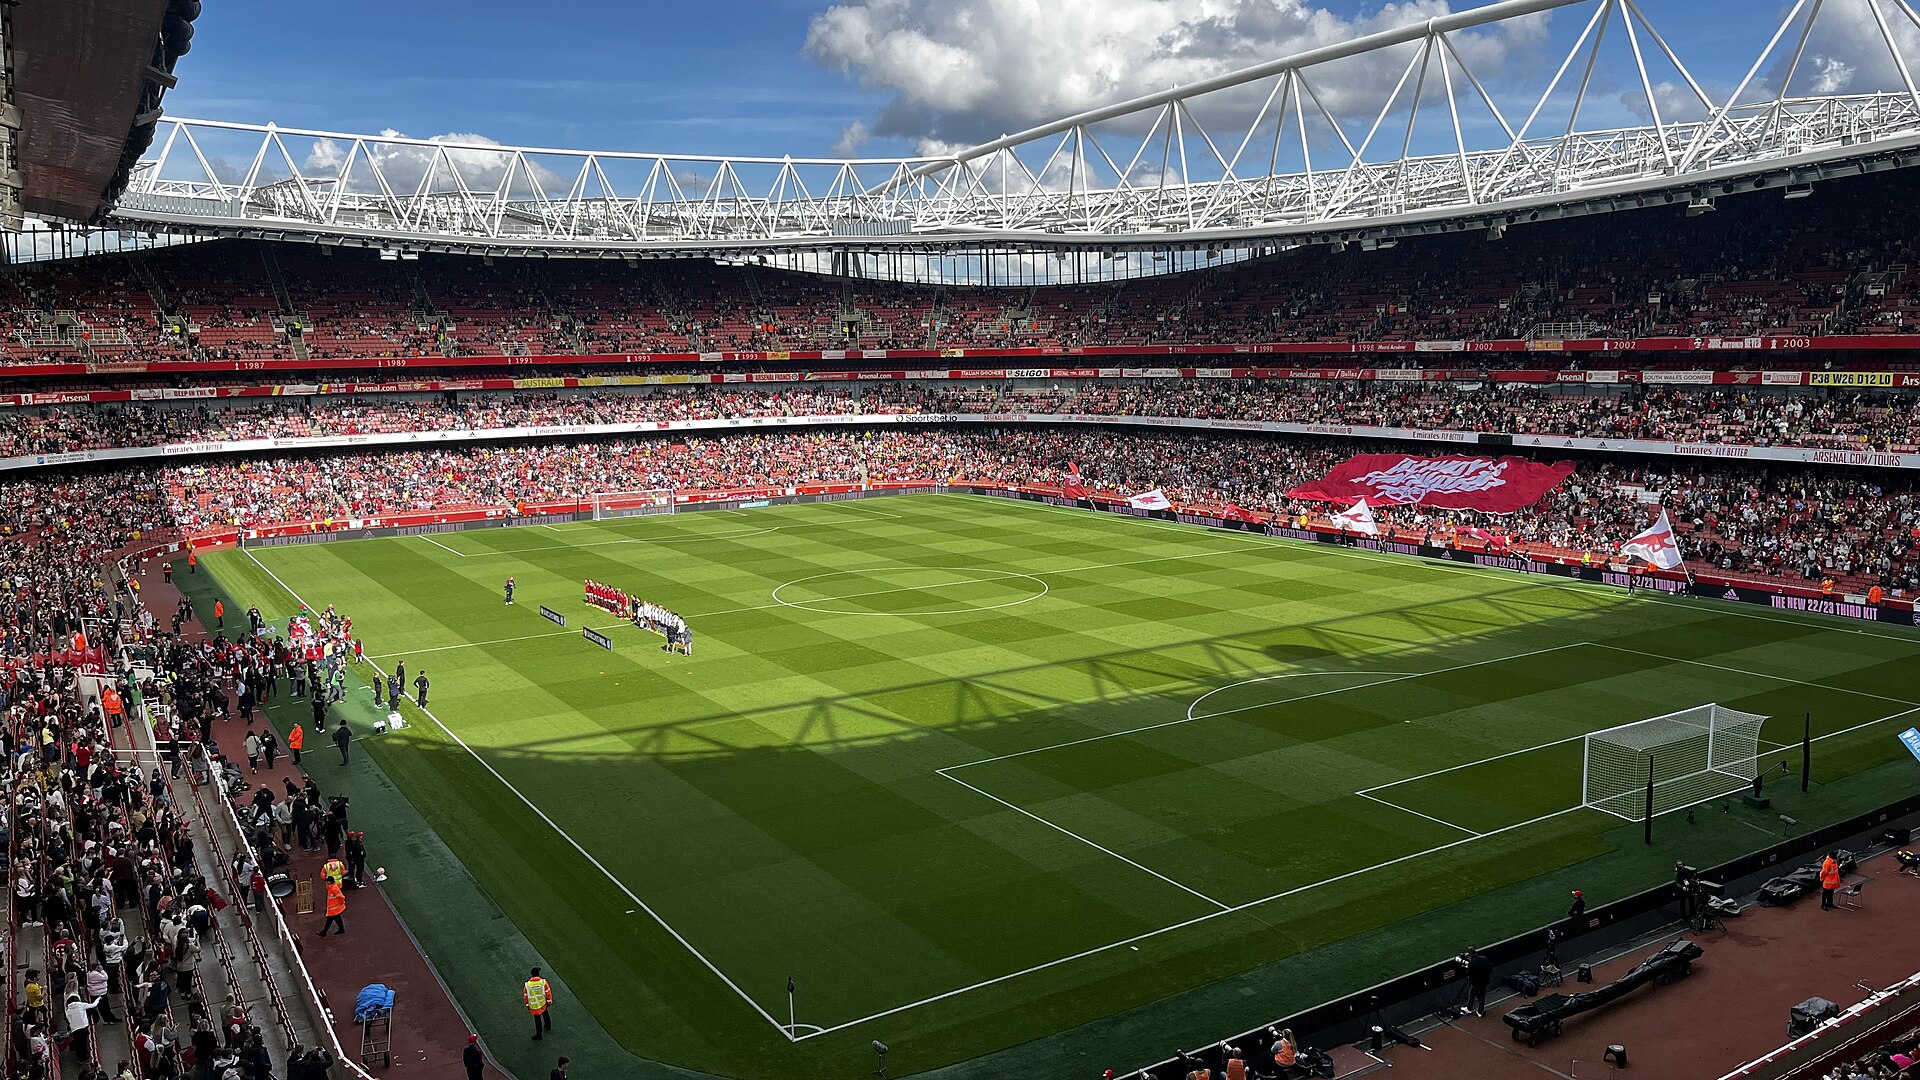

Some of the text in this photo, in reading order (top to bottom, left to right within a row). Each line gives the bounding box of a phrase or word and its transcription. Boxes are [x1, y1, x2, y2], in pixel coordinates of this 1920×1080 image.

[1474, 342, 1494, 351] 2002
[1613, 341, 1636, 349] 2002
[1744, 338, 1761, 348] REYES
[1783, 339, 1810, 348] 2003
[1359, 344, 1375, 352] 1998
[244, 362, 265, 370] 1987
[386, 359, 407, 367] 1989
[1556, 373, 1584, 381] Arsenal
[1811, 373, 1830, 384] P38
[1833, 373, 1854, 384] W26
[1857, 374, 1876, 385] D12
[522, 379, 563, 387] AUSTRALIA
[353, 385, 397, 393] Arsenal.com
[61, 394, 90, 403] Arsenal
[905, 414, 958, 422] Sportsbet.io
[1412, 431, 1440, 440] Emirates
[162, 444, 194, 454] Emirates
[1675, 445, 1748, 457] Emirates FLY BETTER
[262, 539, 274, 547] THE
[274, 538, 288, 546] NEW
[289, 536, 308, 544] 22/23
[309, 535, 326, 543] THIRD
[1474, 554, 1484, 565] THE
[1484, 555, 1497, 566] NEW
[1498, 557, 1517, 569] 22/23
[1536, 562, 1547, 573] KIT
[1601, 572, 1614, 584] THE
[1615, 573, 1630, 586] NEW
[1655, 578, 1677, 591] THIRD
[1771, 595, 1878, 621] THE NEW 22/23 THIRD KIT
